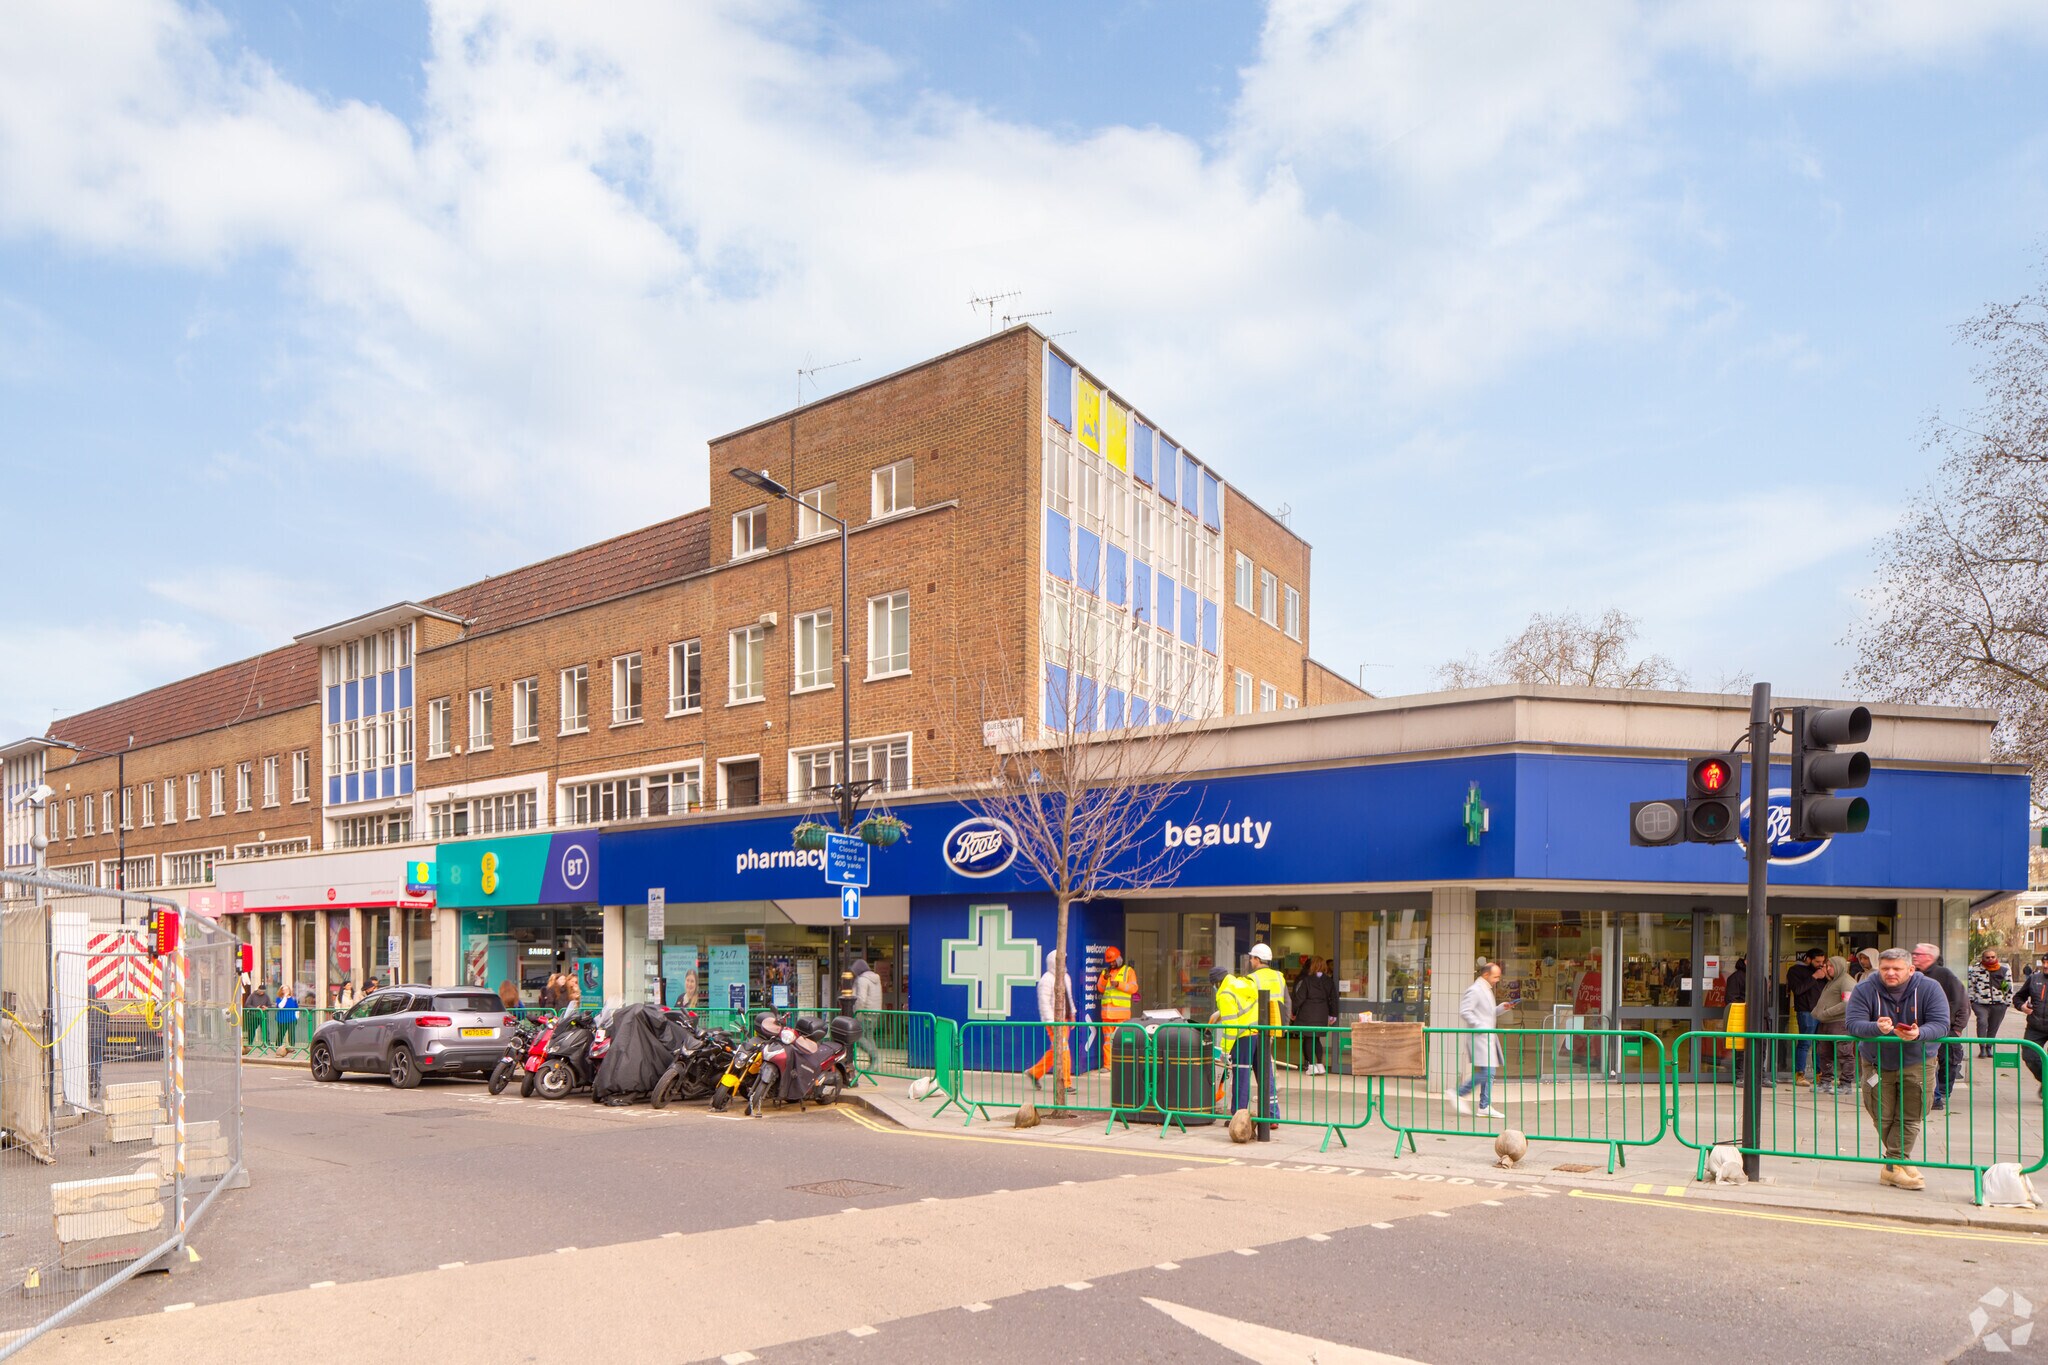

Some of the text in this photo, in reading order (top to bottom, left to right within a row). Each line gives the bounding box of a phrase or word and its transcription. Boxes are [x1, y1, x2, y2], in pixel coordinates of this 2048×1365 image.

[832, 837, 848, 845] Redan
[1165, 816, 1272, 849] beauty
[952, 829, 1002, 863] Boots
[567, 858, 583, 876] BT
[736, 848, 826, 874] pharmacy
[720, 950, 737, 959] 24/7
[1581, 982, 1594, 991] Save
[1579, 990, 1601, 1002] 1/2 pric
[1251, 1161, 1508, 1189] LOOK LEFT
